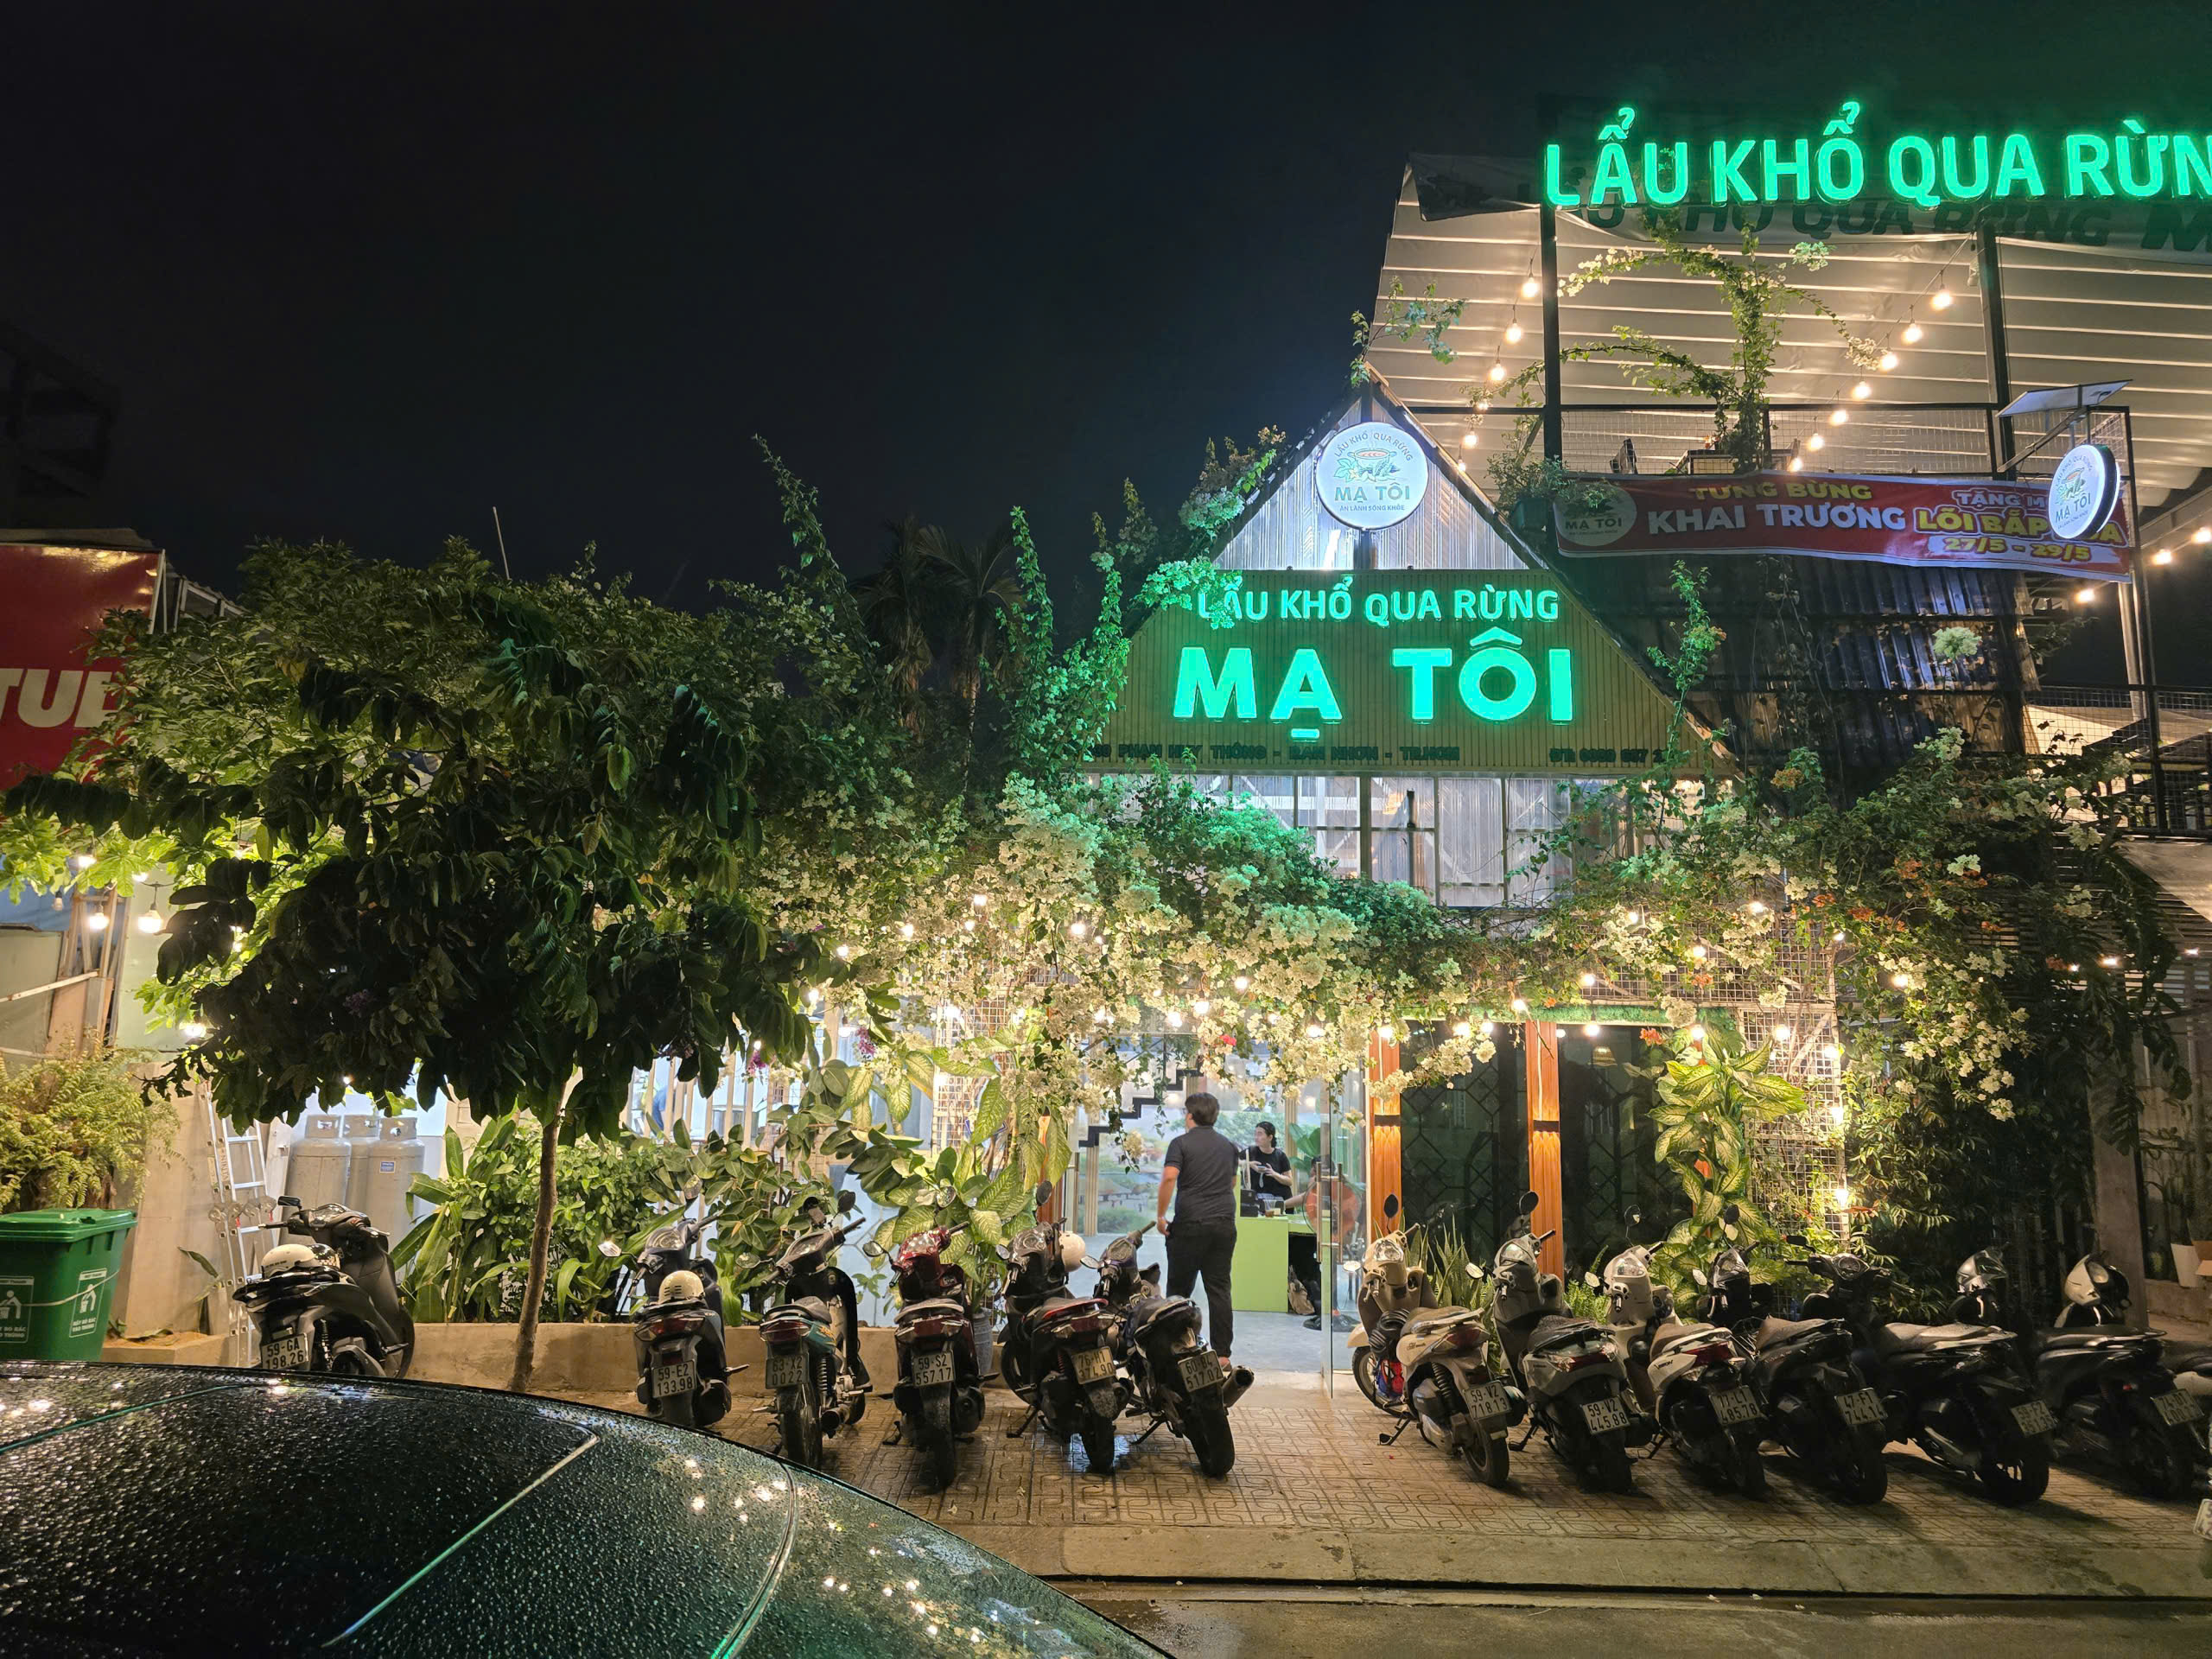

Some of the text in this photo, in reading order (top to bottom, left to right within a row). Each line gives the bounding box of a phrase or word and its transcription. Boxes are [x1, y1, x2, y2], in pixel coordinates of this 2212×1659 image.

[1546, 105, 1689, 207] LẨU
[1712, 100, 1866, 206] KHỔ
[1888, 133, 2047, 209] QUA
[1373, 432, 1392, 443] QUA
[1334, 482, 1410, 503] MẠ TÔI
[2074, 493, 2091, 512] TÔI
[1647, 501, 1908, 536] KHAI TRƯƠNG
[1917, 507, 1976, 532] LÕI
[1943, 537, 2007, 554] 27/5
[2031, 543, 2092, 563] 29/5
[1198, 575, 1560, 628] LẨU KHỔ QUA RỪNG
[1172, 626, 1576, 743] MẠ TÔI
[1210, 741, 1268, 760] THÔNG
[266, 1337, 300, 1358] 59-GA
[265, 1350, 304, 1370] 198.26
[918, 1353, 948, 1370] 59-S2
[1078, 1351, 1106, 1368] 76-H1
[658, 1363, 690, 1382] 59-E2
[772, 1370, 803, 1386] 0022
[916, 1367, 951, 1385] 557.17
[657, 1376, 694, 1396] 133.98
[1471, 1384, 1500, 1403] 59-V2
[1586, 1398, 1618, 1418] 59-V2
[1590, 1412, 1628, 1432] 445.88
